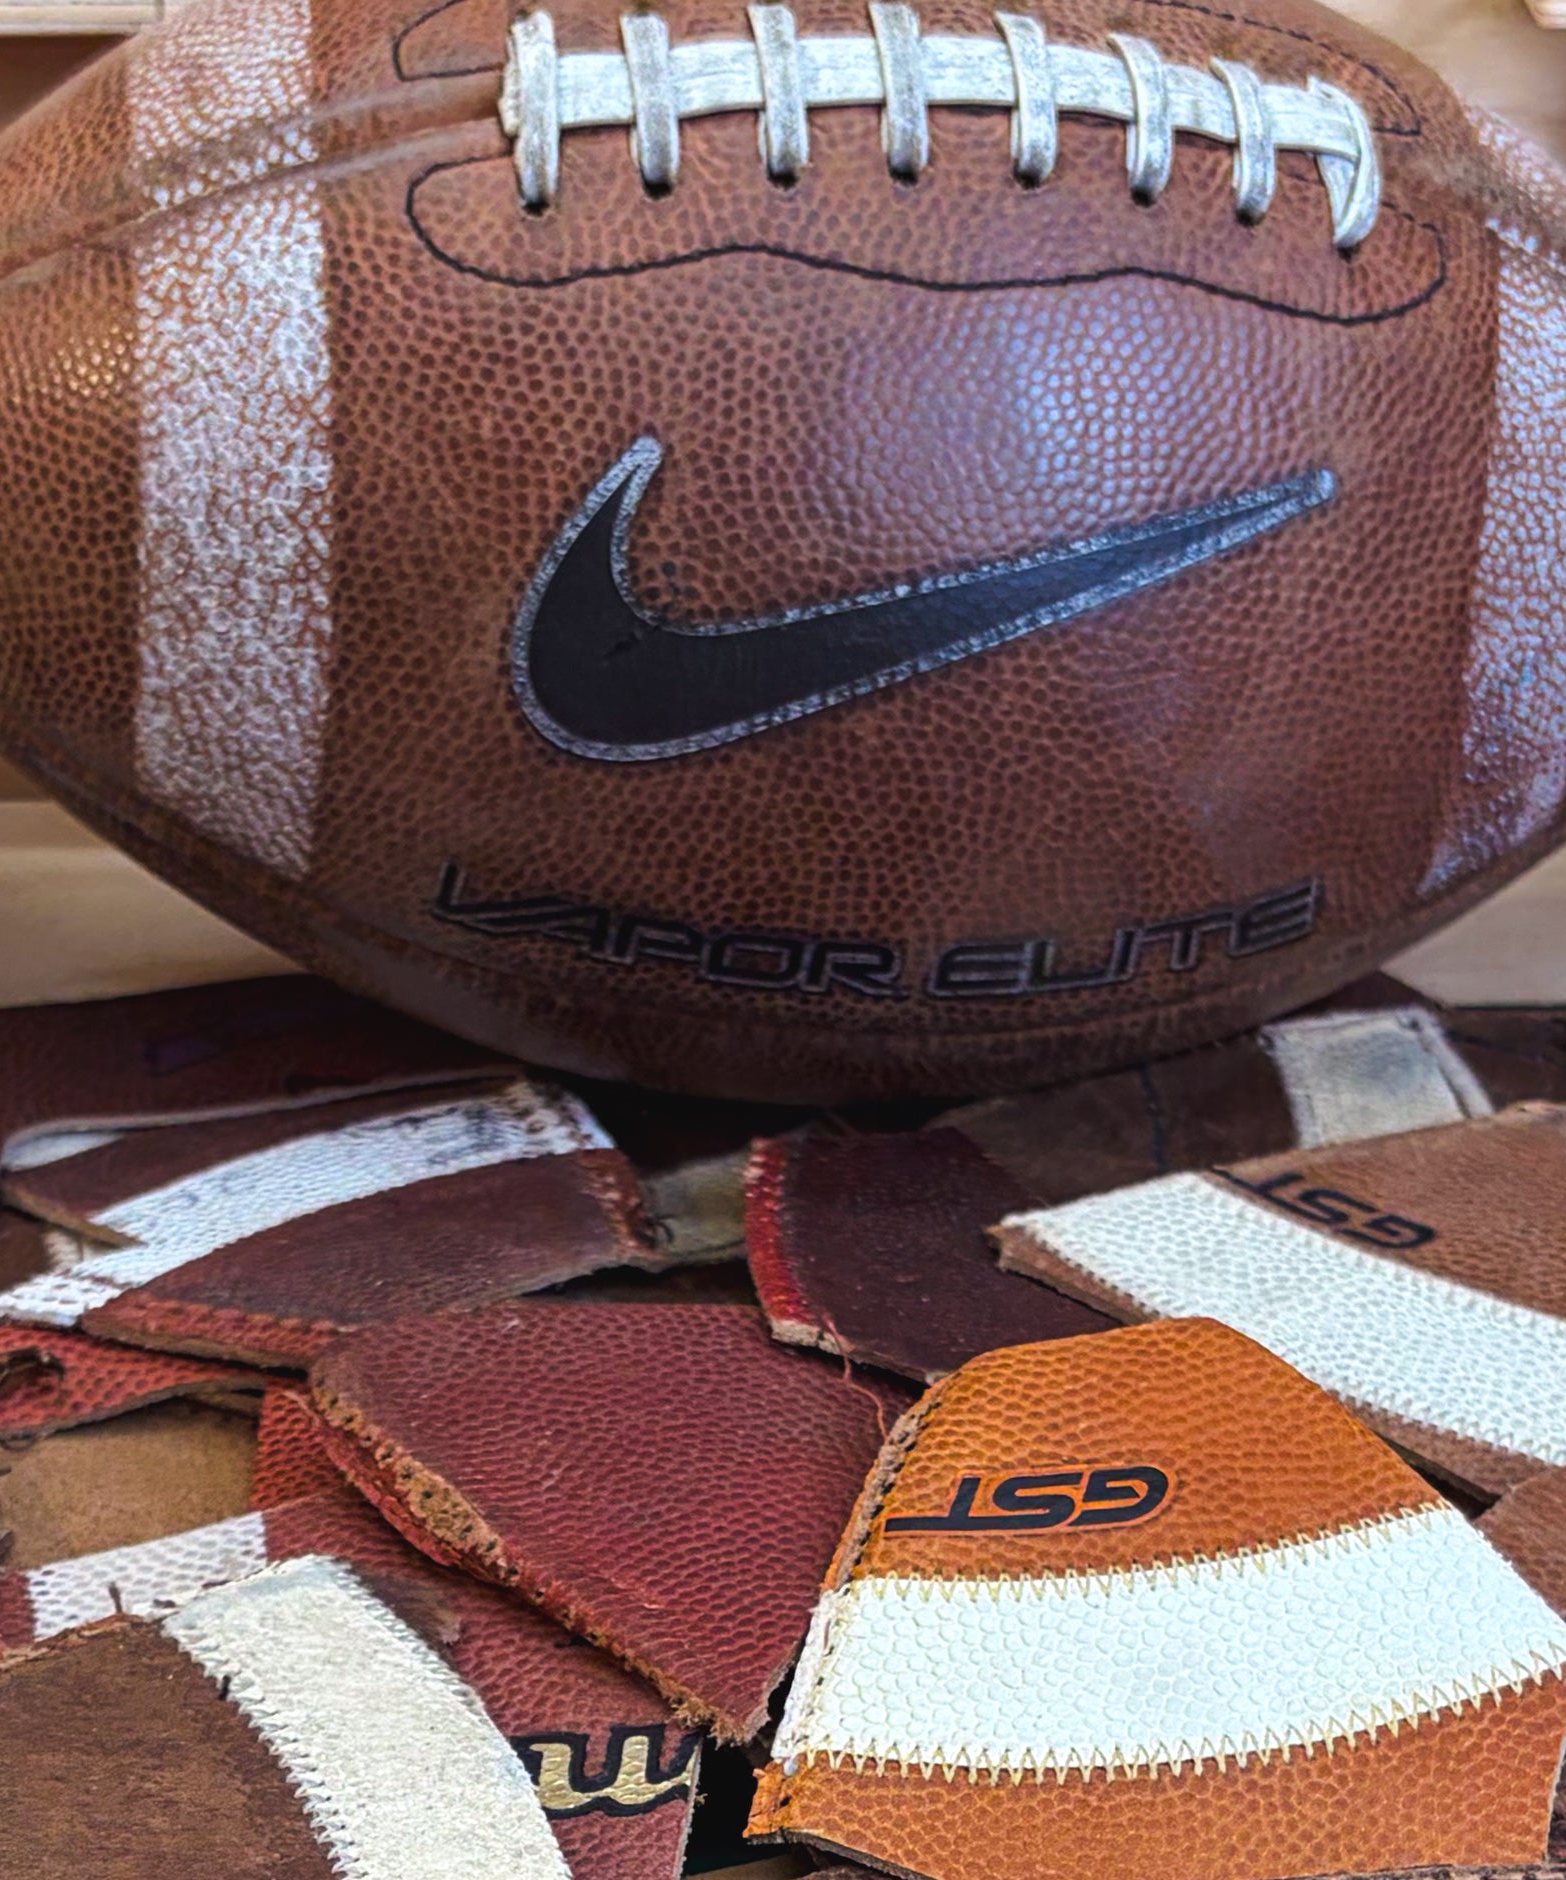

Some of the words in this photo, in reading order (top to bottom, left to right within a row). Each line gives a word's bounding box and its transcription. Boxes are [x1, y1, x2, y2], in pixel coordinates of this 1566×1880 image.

[432, 858, 911, 1000] VAPOR
[926, 875, 1322, 999] ELITE
[883, 1465, 1170, 1534] GST
